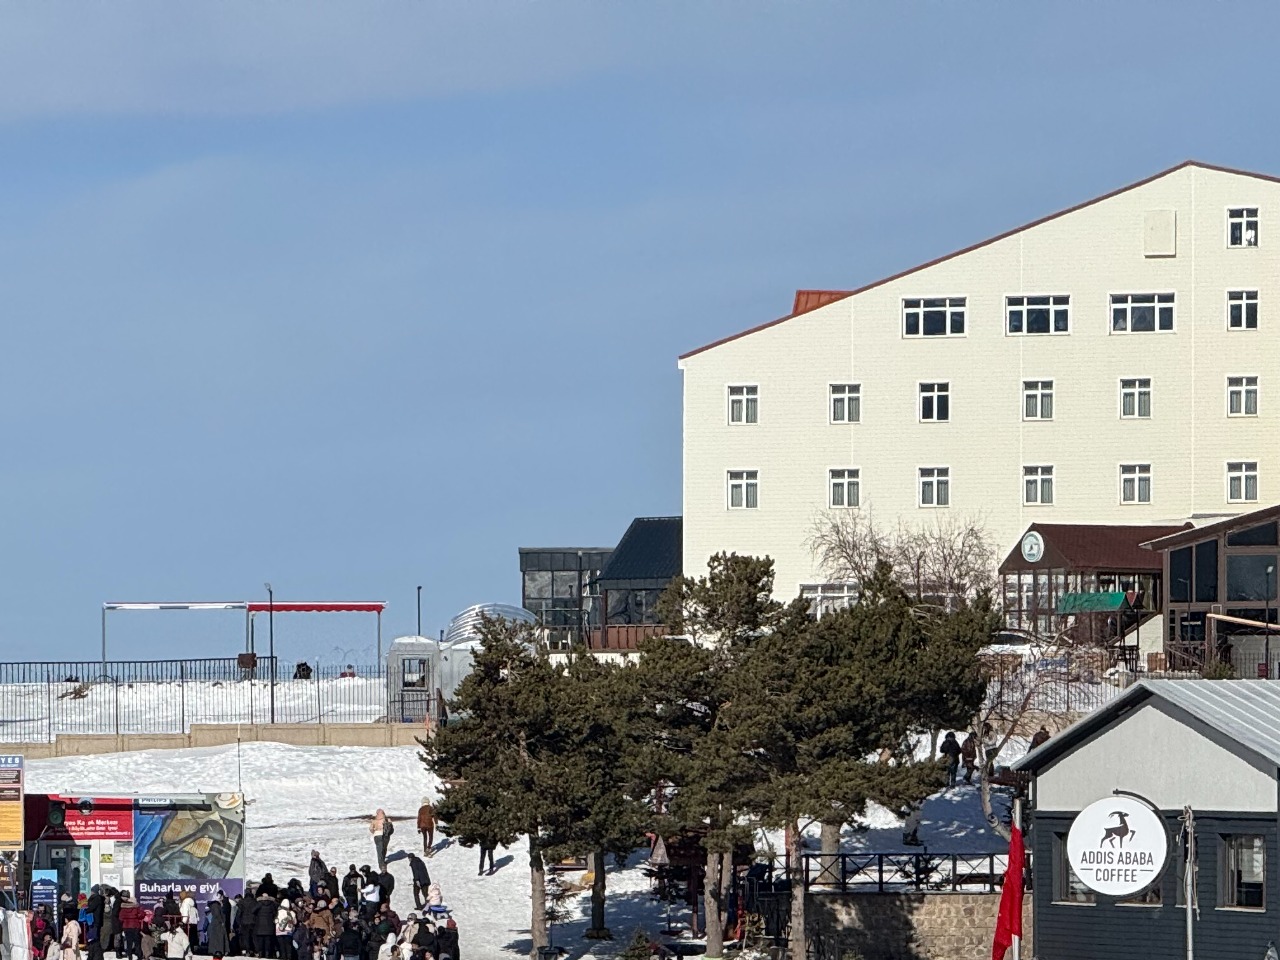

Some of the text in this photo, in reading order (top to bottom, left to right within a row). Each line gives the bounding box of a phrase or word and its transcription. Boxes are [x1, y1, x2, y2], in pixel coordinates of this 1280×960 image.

[1080, 850, 1154, 865] ADDIS ABABA
[1095, 868, 1138, 882] COFFEE
[139, 882, 220, 895] Buharla ve giy!
